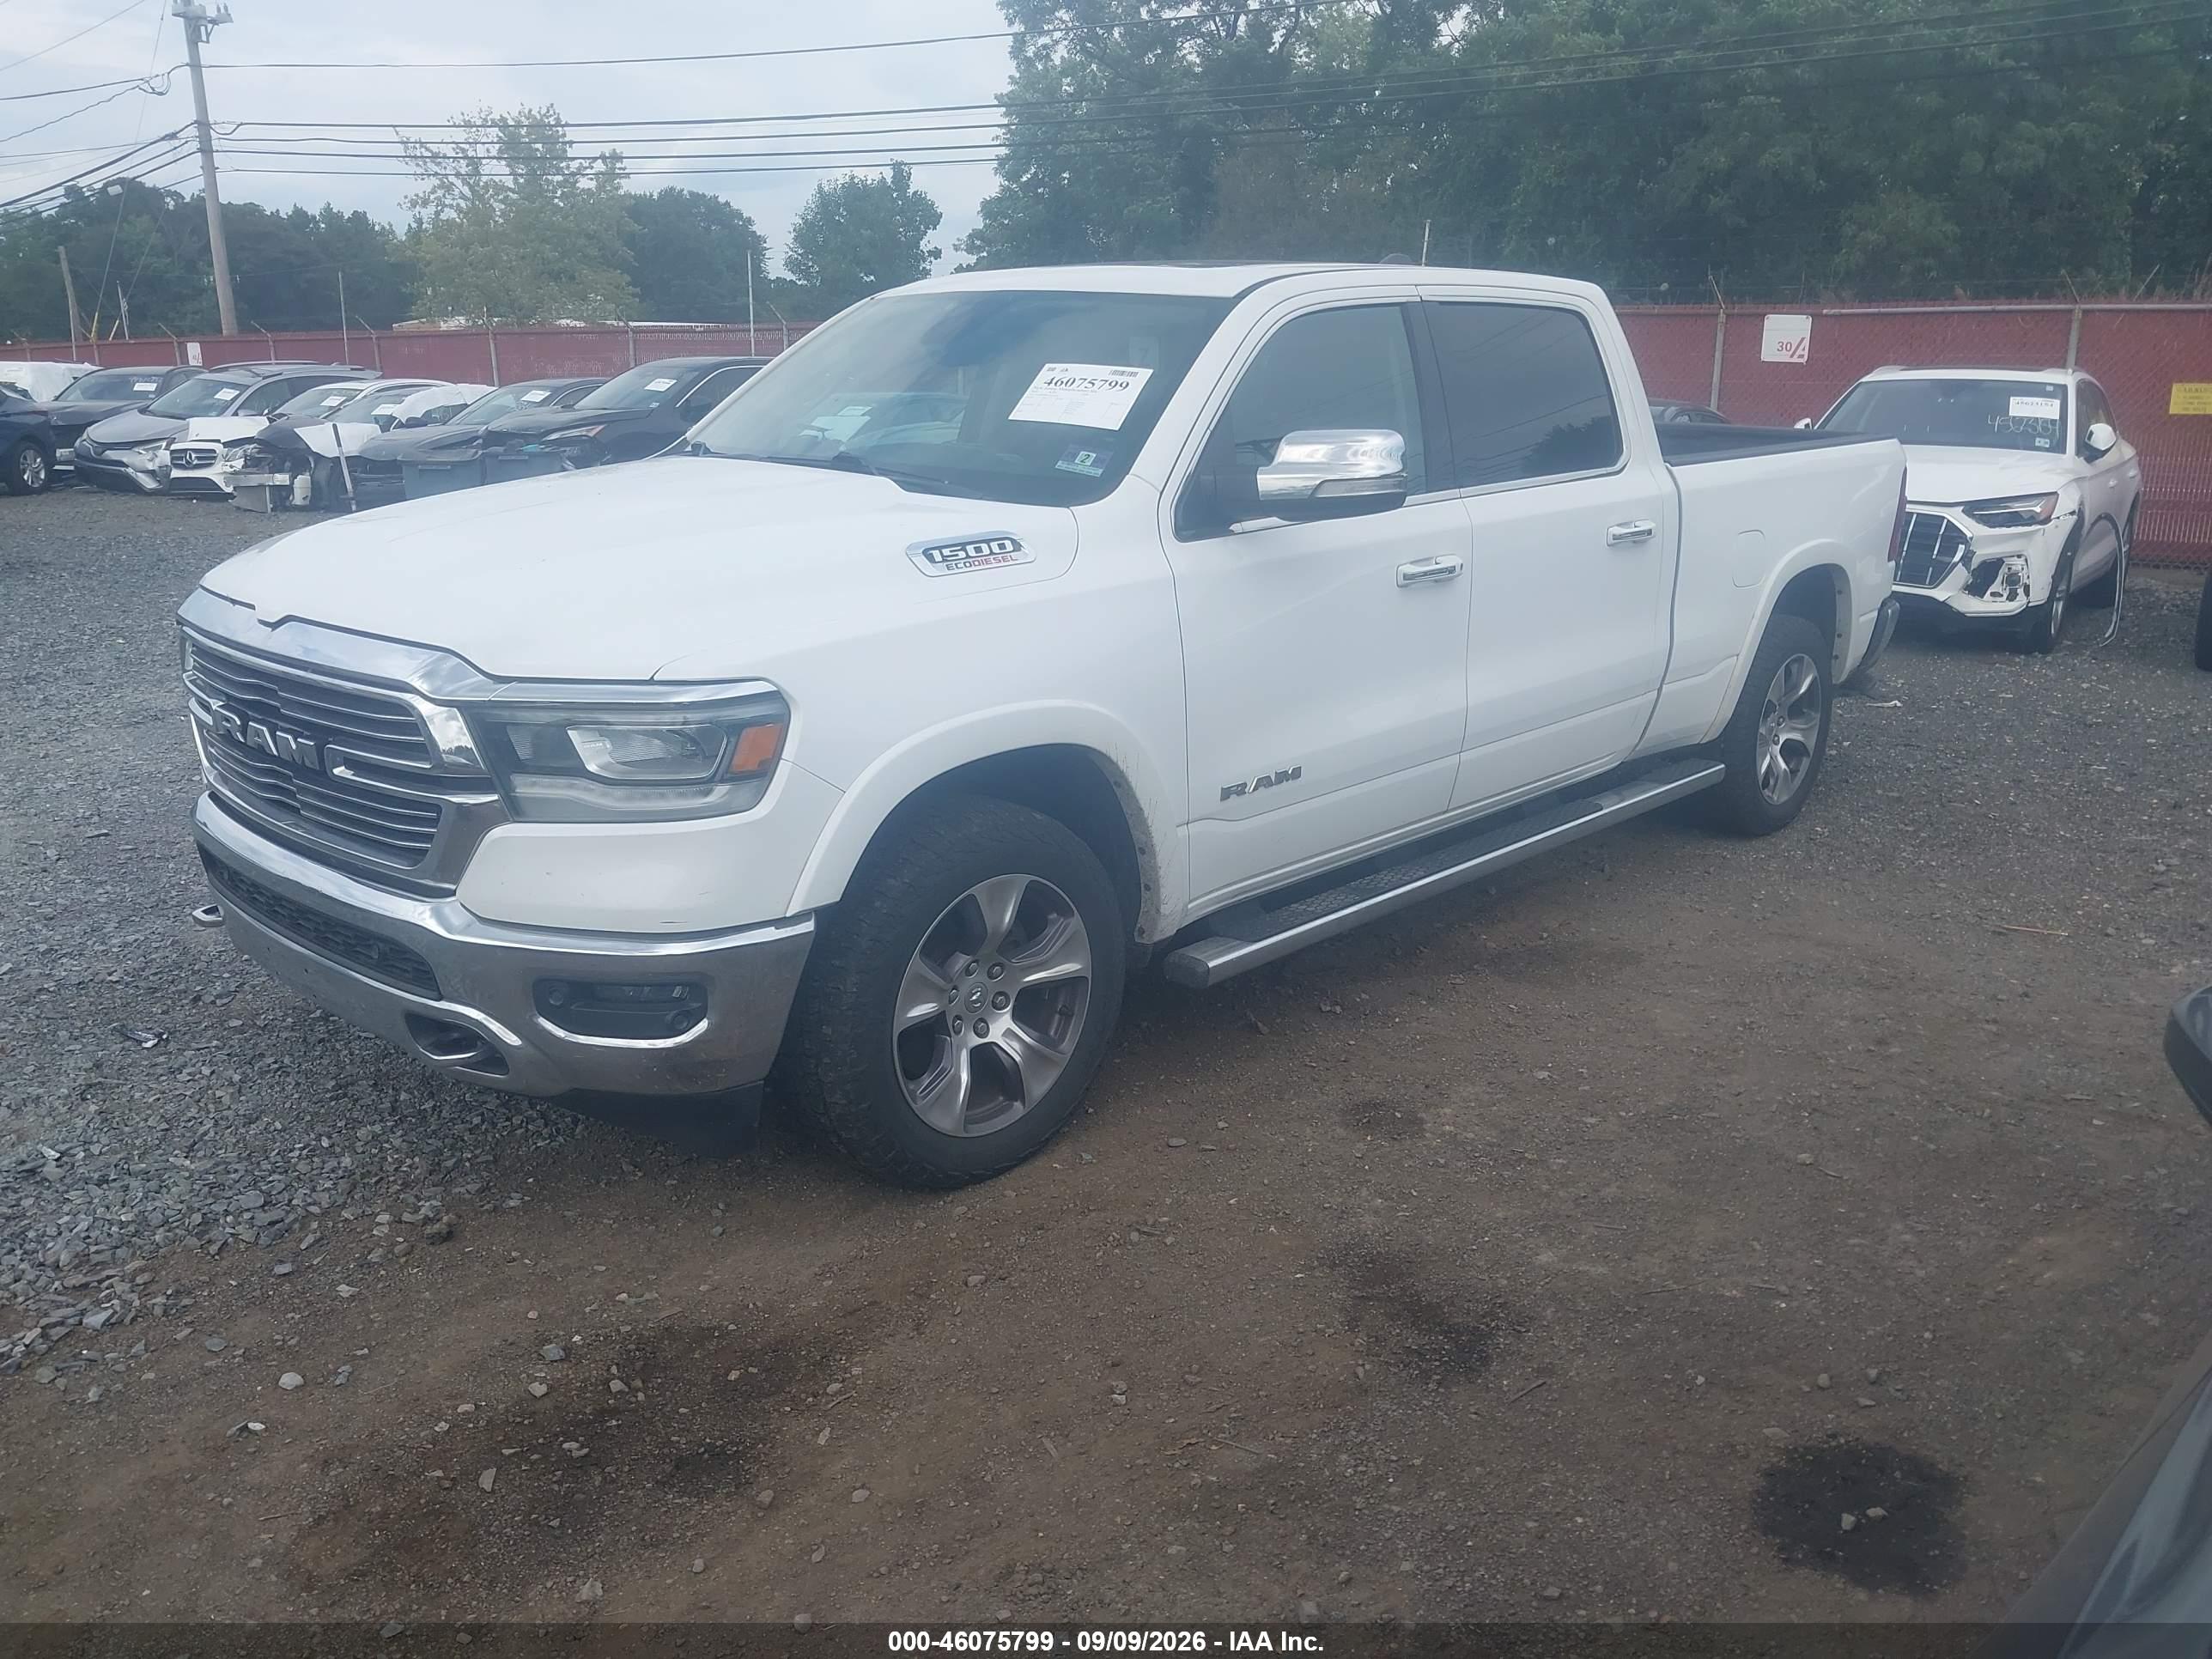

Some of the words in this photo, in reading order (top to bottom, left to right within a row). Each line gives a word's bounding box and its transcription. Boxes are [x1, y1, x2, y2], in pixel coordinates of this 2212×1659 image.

[1043, 375, 1130, 392] 46075799
[927, 540, 1014, 562] 1500
[945, 555, 1018, 571] ECODIESEL
[215, 707, 319, 770] RAM
[1220, 765, 1302, 802] RAM
